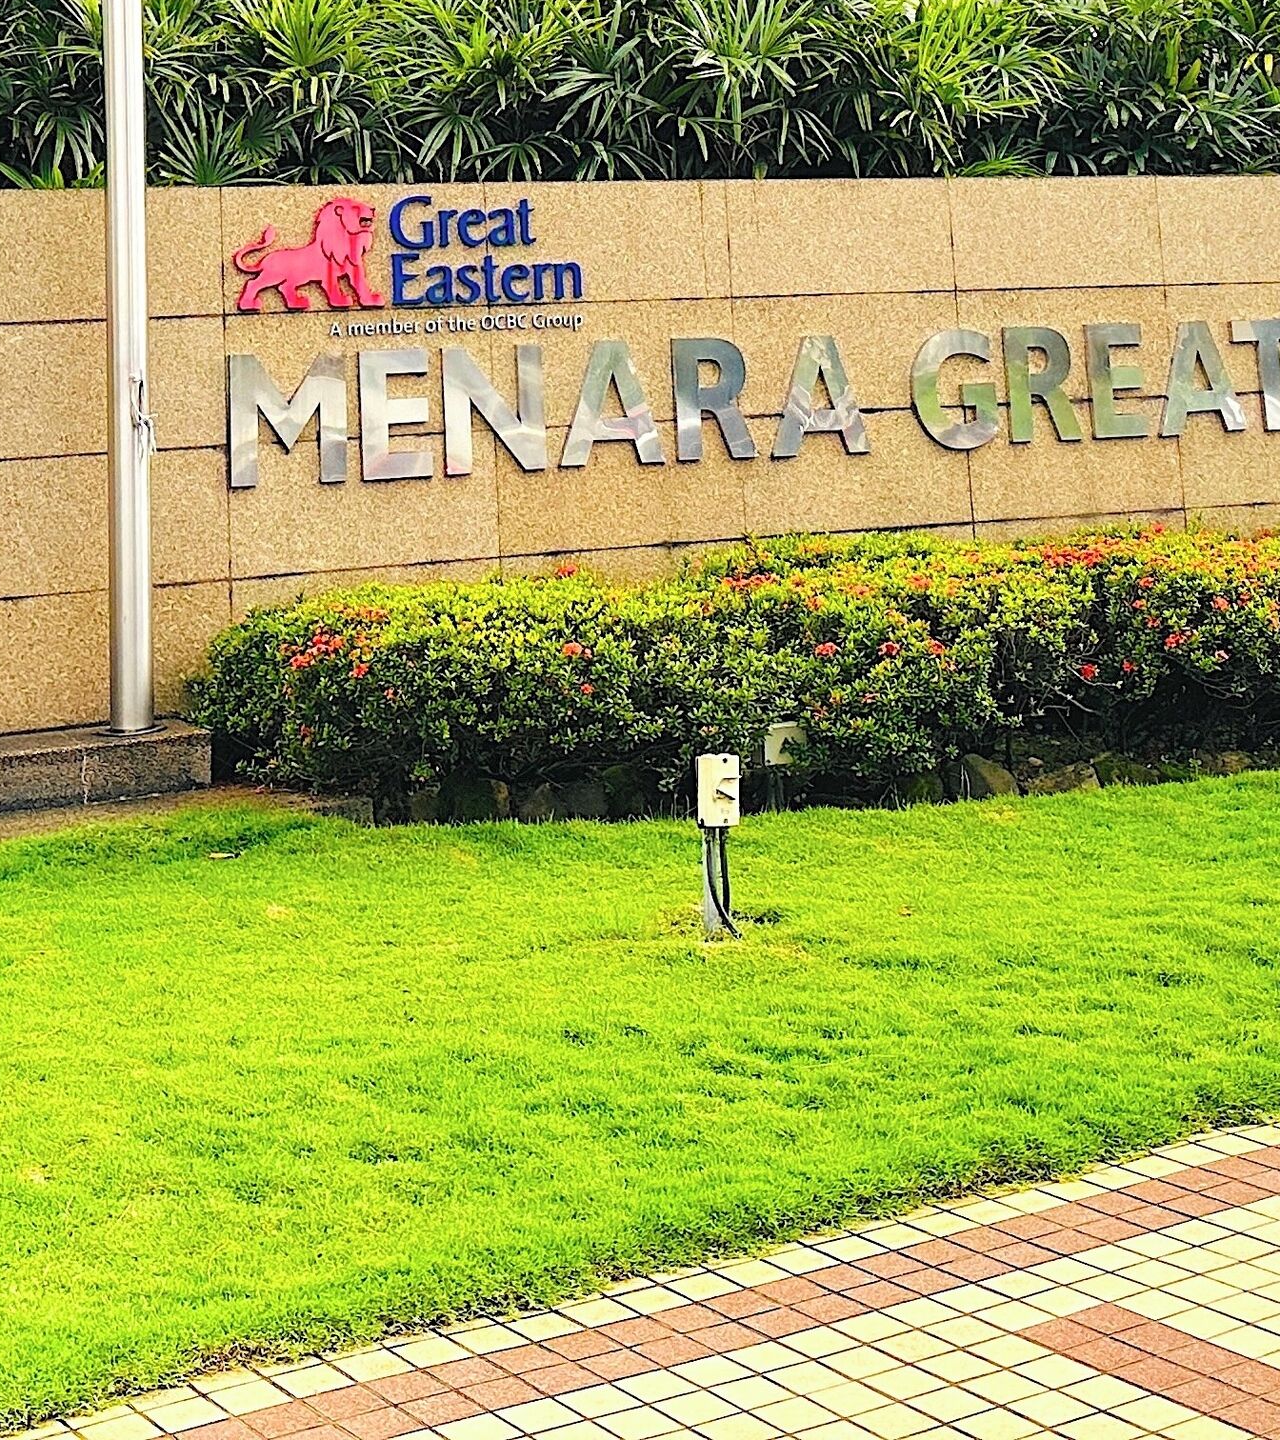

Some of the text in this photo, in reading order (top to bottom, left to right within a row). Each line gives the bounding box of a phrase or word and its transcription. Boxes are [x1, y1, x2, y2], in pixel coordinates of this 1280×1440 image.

[389, 195, 537, 250] Great
[391, 252, 584, 306] Eastern
[329, 312, 585, 337] A member of the OCBC Group
[227, 335, 871, 489] MENARA
